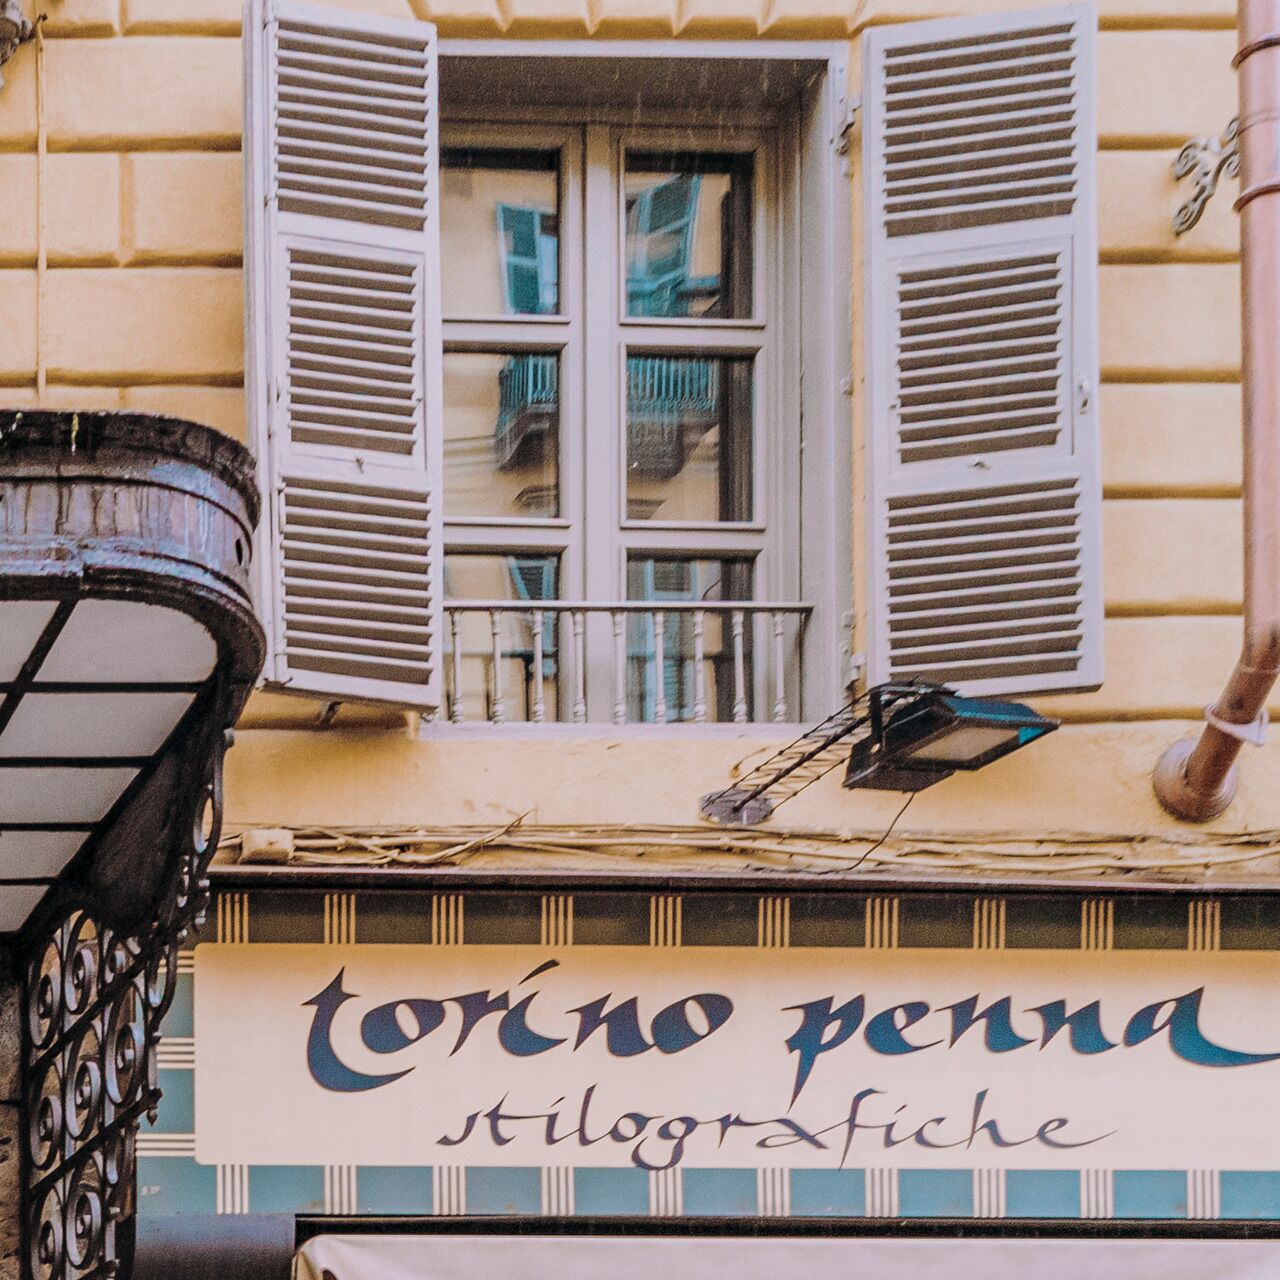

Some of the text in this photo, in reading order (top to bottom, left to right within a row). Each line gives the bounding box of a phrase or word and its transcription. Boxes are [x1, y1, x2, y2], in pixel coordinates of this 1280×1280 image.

[303, 960, 1280, 1112] torino penna
[436, 1083, 1118, 1170] stilografiche
